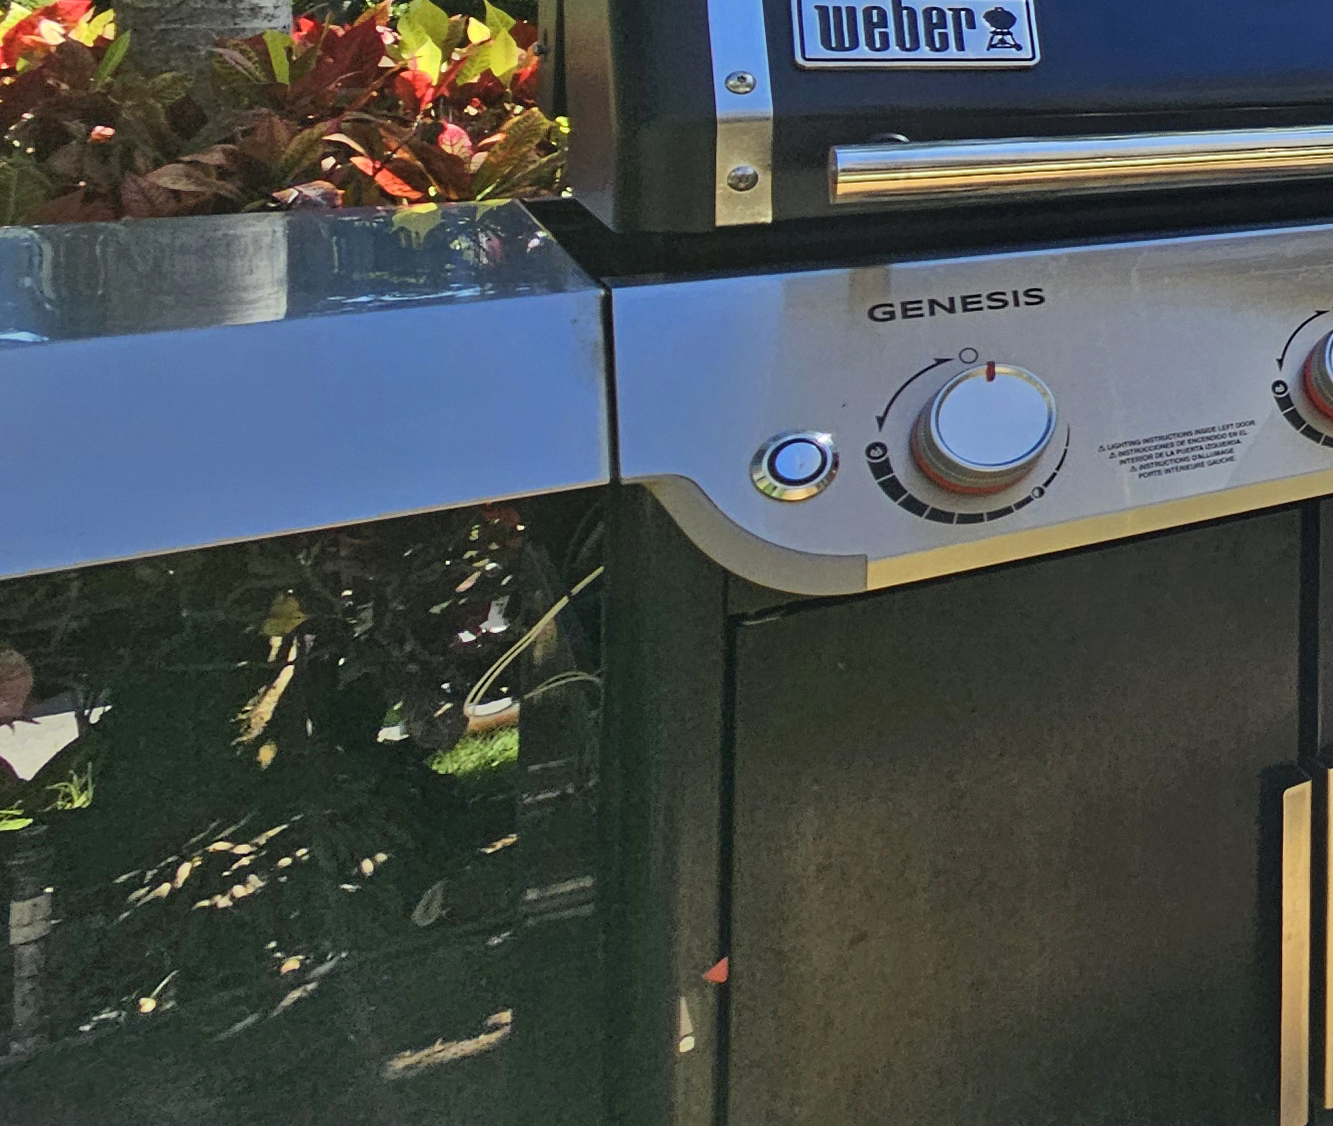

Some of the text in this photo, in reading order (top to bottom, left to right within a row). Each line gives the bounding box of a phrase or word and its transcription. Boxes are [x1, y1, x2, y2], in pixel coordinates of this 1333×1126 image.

[867, 287, 1046, 323] GENESIS
[1107, 439, 1142, 451] LIGHTING
[1142, 430, 1193, 444] INSTRUCTIONS
[1194, 426, 1217, 436] INSIDE
[1218, 423, 1234, 432] LEFT
[1118, 428, 1248, 457] INSTRUCCIONES DE ENCENDIDO EN EL
[1119, 453, 1154, 466] INTERIOR
[1155, 451, 1164, 460] DE
[1165, 449, 1175, 457] LA
[1175, 444, 1204, 455] PUERTA
[1138, 448, 1234, 471] INSTRUCTIONS D'ALLUMAGE
[1138, 469, 1163, 479] PORTE
[1164, 461, 1206, 474] INTÉRIEURE
